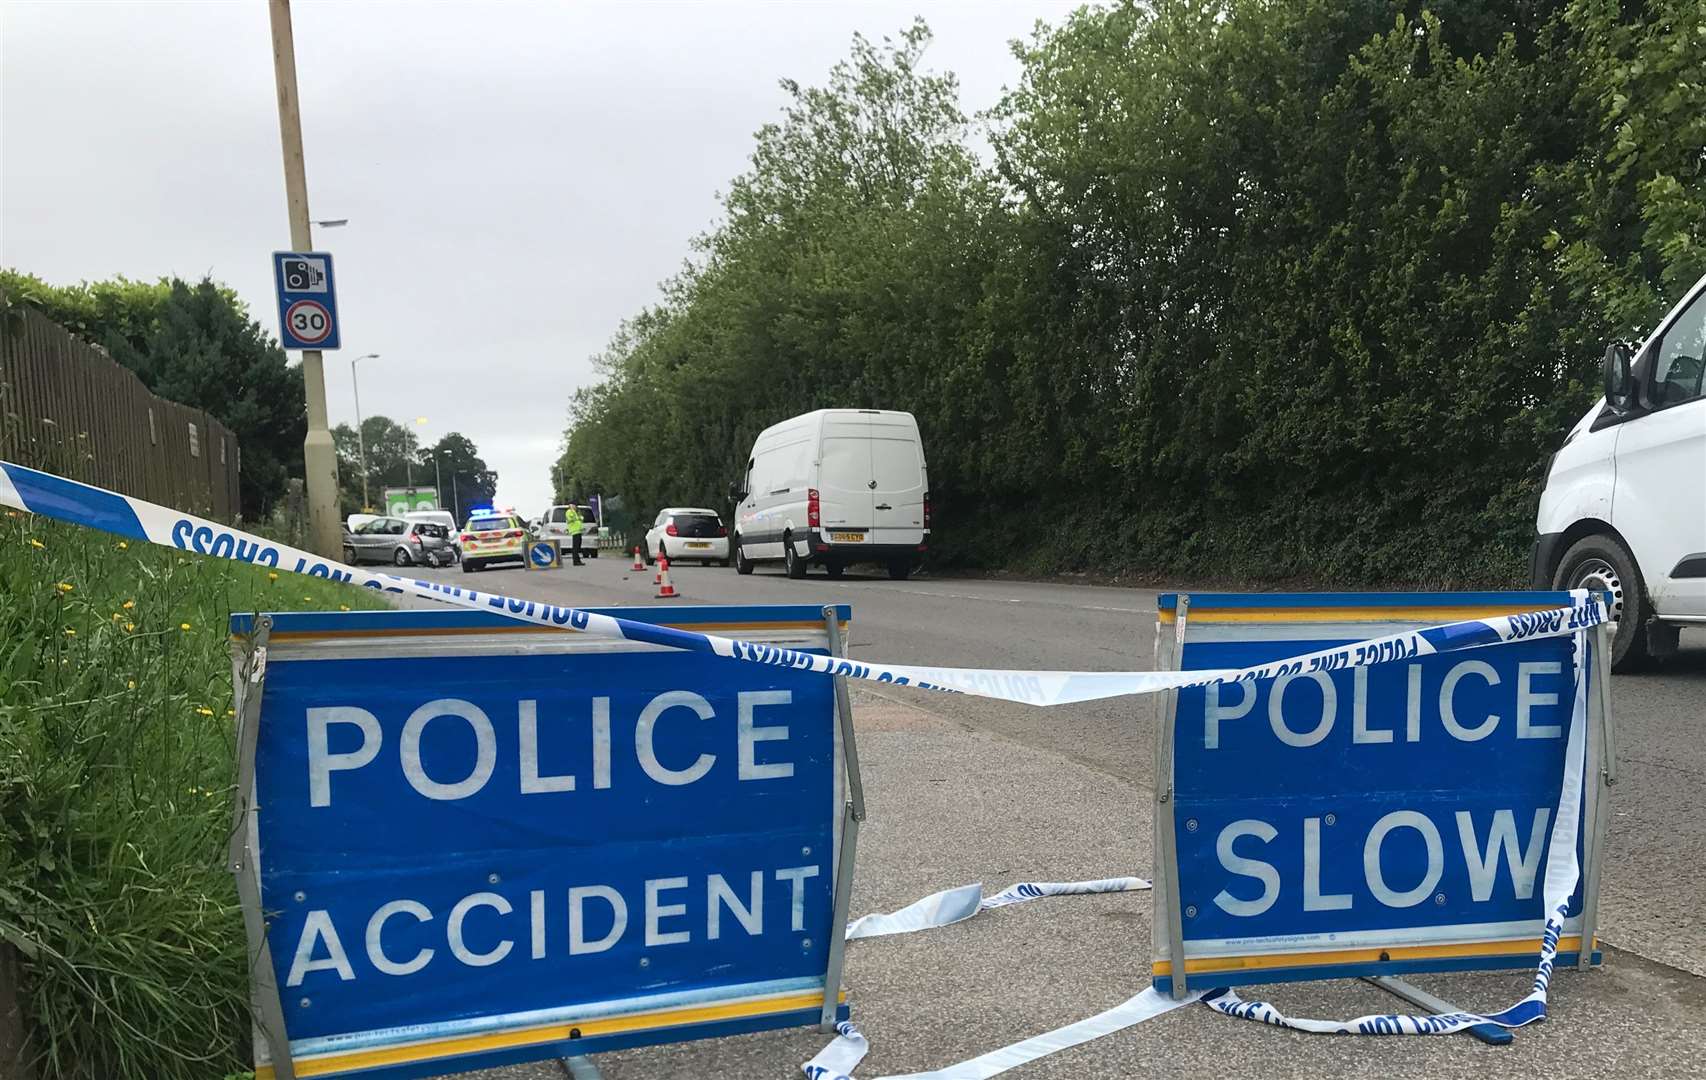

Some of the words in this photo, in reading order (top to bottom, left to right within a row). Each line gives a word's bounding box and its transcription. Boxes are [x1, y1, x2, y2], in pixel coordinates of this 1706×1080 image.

[294, 313, 325, 330] 30
[1507, 610, 1564, 641] CROSS
[306, 690, 794, 808] POLICE
[1204, 660, 1562, 750] POLICE
[1213, 808, 1551, 917] SLOW
[286, 865, 819, 987] ACCIDENT
